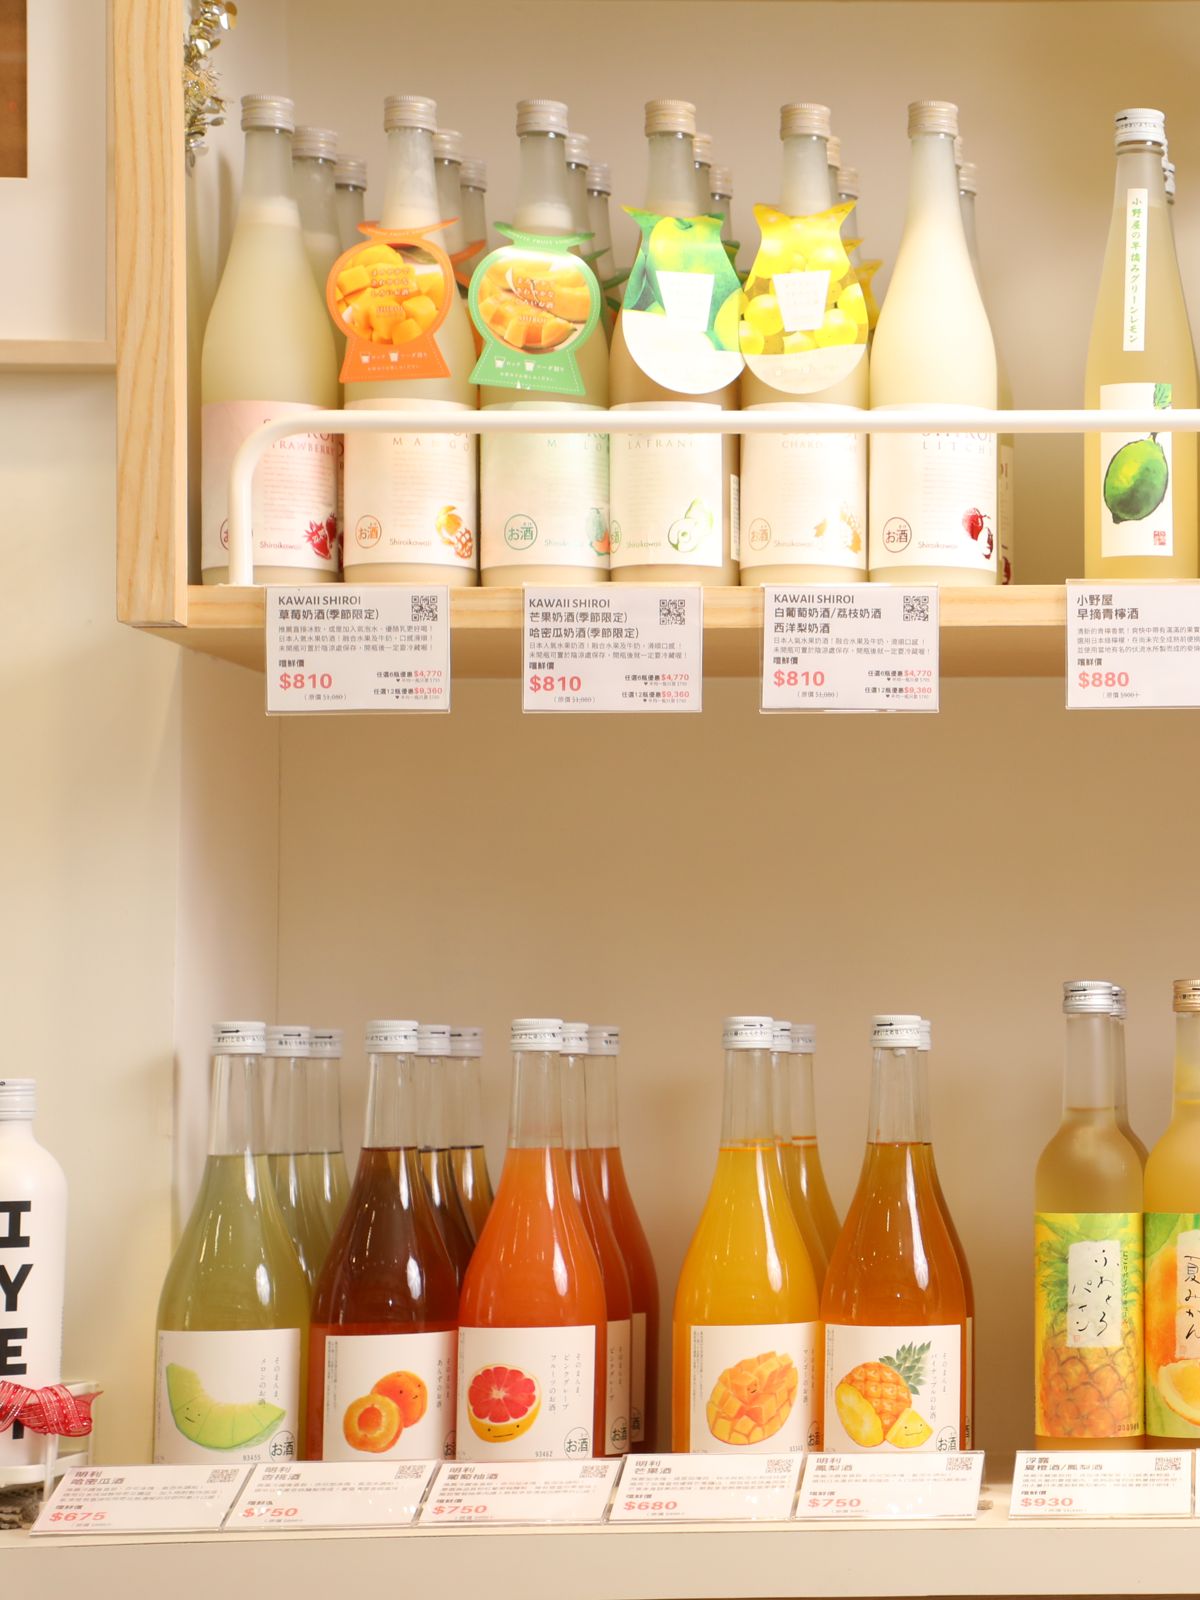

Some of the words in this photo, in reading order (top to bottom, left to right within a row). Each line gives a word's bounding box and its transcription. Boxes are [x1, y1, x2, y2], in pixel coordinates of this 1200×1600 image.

[508, 525, 534, 541] お酒
[886, 528, 909, 544] お酒
[278, 596, 320, 606] KAWAII
[322, 596, 361, 606] SHIROI
[529, 599, 570, 609] KAWAII
[572, 599, 610, 609] SHIROI
[774, 594, 815, 604] KAWAII
[817, 594, 854, 604] SHIROI
[1077, 594, 1114, 606] 小野屋
[278, 608, 380, 620] 草莓奶酒(季節限定)
[529, 611, 628, 623] 芒果奶酒(季節限定)
[774, 607, 882, 620] 白葡萄奶酒/荔枝奶酒
[1077, 607, 1139, 620] 早摘青檸酒
[529, 627, 639, 639] 哈密瓜奶酒(季節限定)
[774, 622, 830, 634] 西洋梨奶酒
[279, 672, 333, 691] $810
[529, 674, 582, 693] $810
[774, 669, 825, 688] $810
[1078, 670, 1129, 689] $880
[565, 1437, 589, 1453] お酒
[815, 1464, 853, 1472] 鳳梨酒
[70, 1477, 126, 1486] 哈密瓜酒
[623, 1501, 678, 1511] $680
[807, 1498, 862, 1508] $750
[1020, 1497, 1074, 1508] $930
[242, 1507, 299, 1518] $750
[432, 1505, 488, 1515] $750
[49, 1511, 107, 1523] $675
